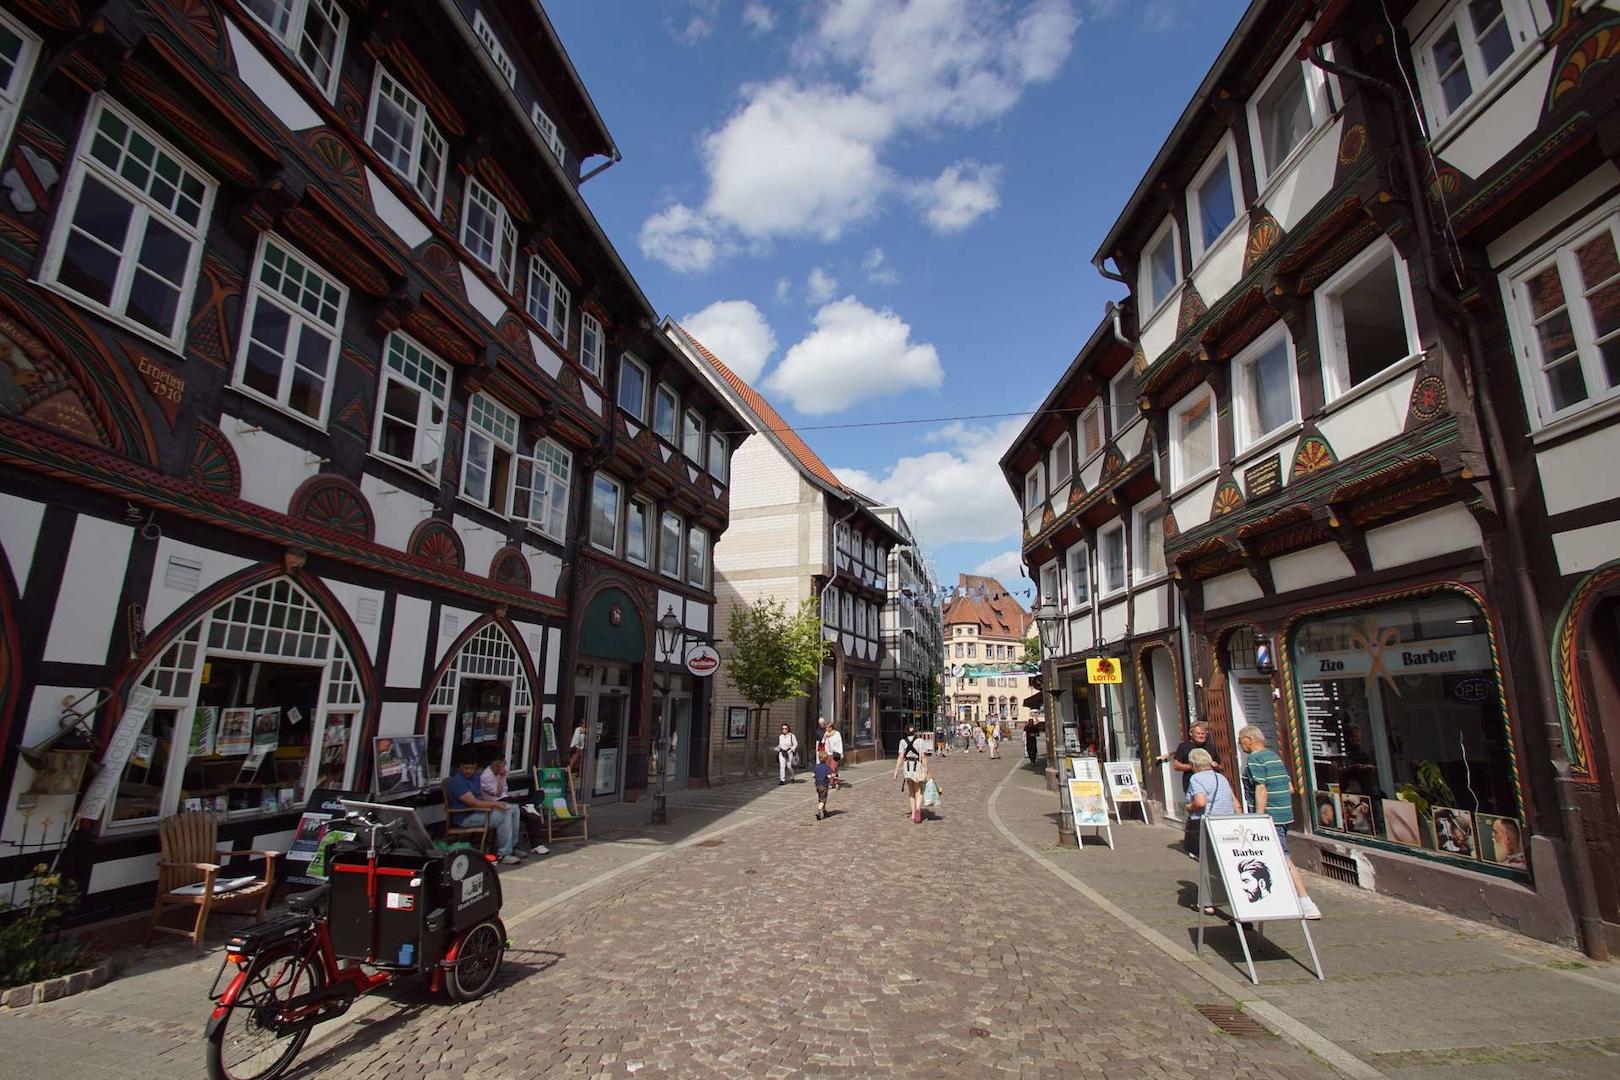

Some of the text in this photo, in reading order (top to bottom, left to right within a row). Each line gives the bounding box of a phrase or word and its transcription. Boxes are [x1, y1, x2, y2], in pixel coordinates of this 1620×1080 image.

[152, 381, 182, 403] 1910
[1319, 648, 1457, 672] Zizo Barber
[1093, 674, 1117, 682] LOTTO
[1251, 833, 1270, 842] Zizo
[1232, 848, 1264, 857] Barber
